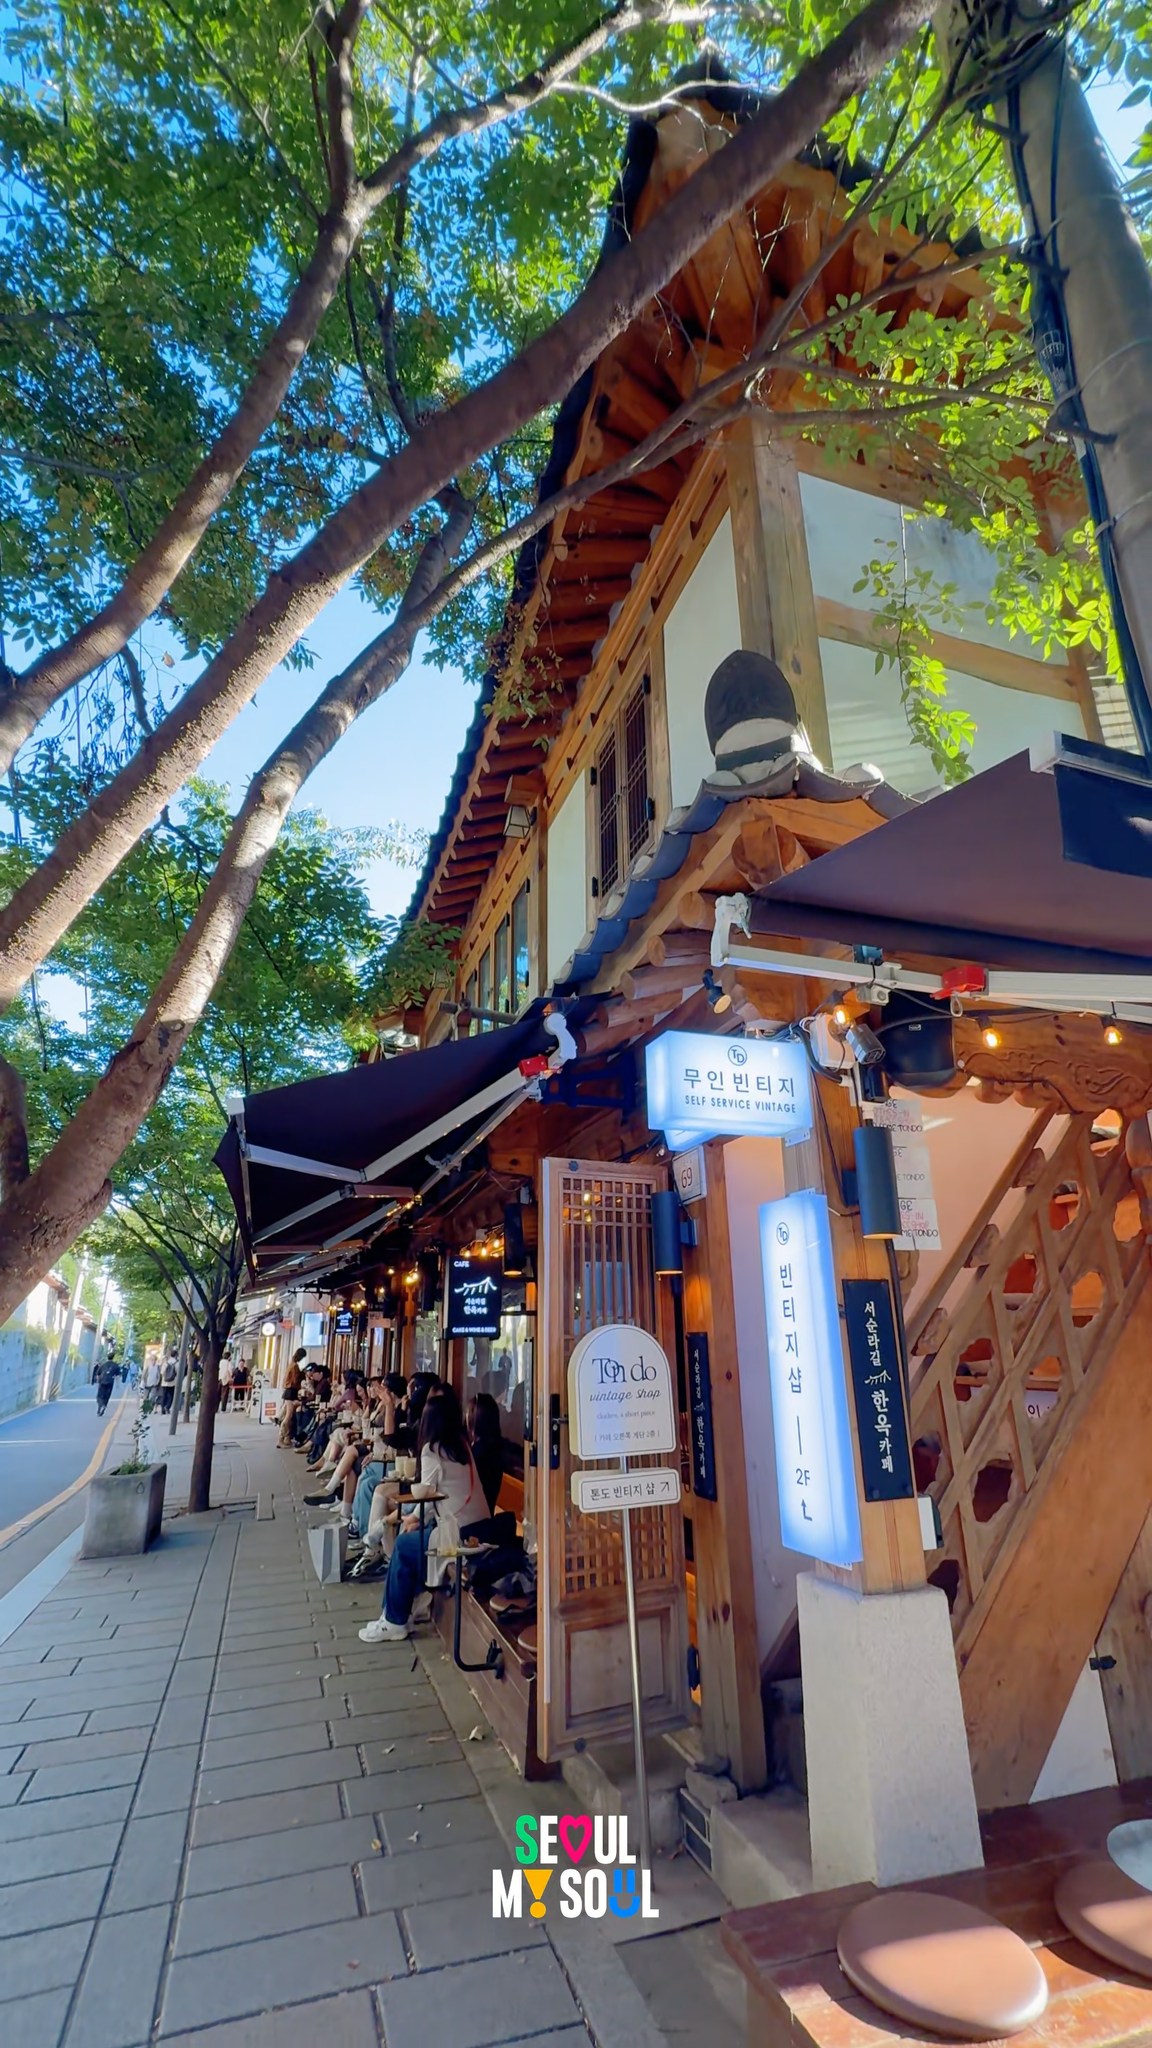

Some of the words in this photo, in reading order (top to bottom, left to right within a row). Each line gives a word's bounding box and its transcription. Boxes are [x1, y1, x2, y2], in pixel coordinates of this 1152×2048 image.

[685, 1095, 706, 1106] SELF
[711, 1098, 751, 1110] SERVICE
[755, 1101, 796, 1113] VINTAGE
[681, 1167, 693, 1188] 69
[779, 1263, 802, 1393] 빈티지샵
[864, 1301, 882, 1366] 서순라길
[589, 1389, 633, 1403] vintage
[871, 1389, 893, 1474] 한옥카페
[796, 1468, 810, 1487] 2F
[590, 1488, 611, 1501] 톤도
[613, 1484, 642, 1499] 빈티지
[645, 1482, 655, 1495] 샵
